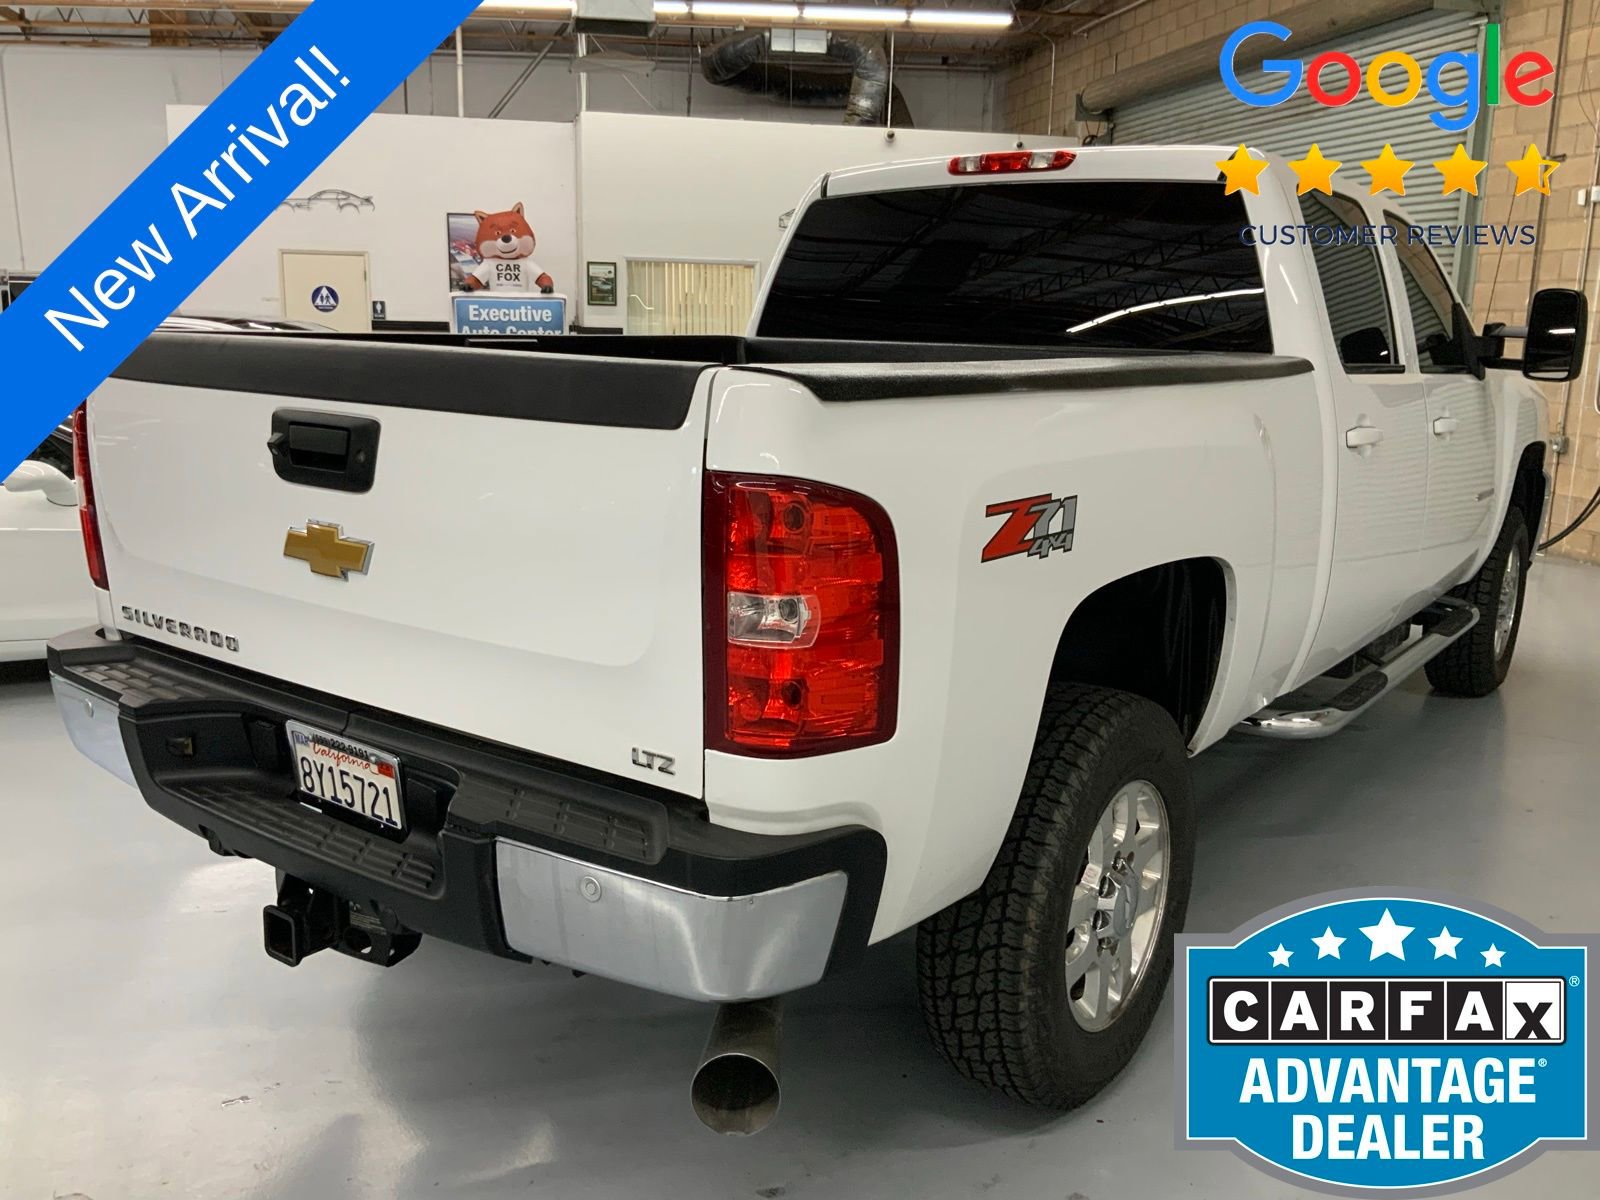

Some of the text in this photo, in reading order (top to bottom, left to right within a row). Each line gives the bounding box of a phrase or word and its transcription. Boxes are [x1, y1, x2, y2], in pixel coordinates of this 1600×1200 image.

[496, 263, 521, 272] CAR
[497, 272, 521, 282] FOX
[469, 304, 552, 322] Executive
[981, 493, 1078, 563] Z71
[121, 605, 240, 653] SILVERADO
[632, 747, 676, 775] LTZ
[300, 756, 398, 828] 8Y15721
